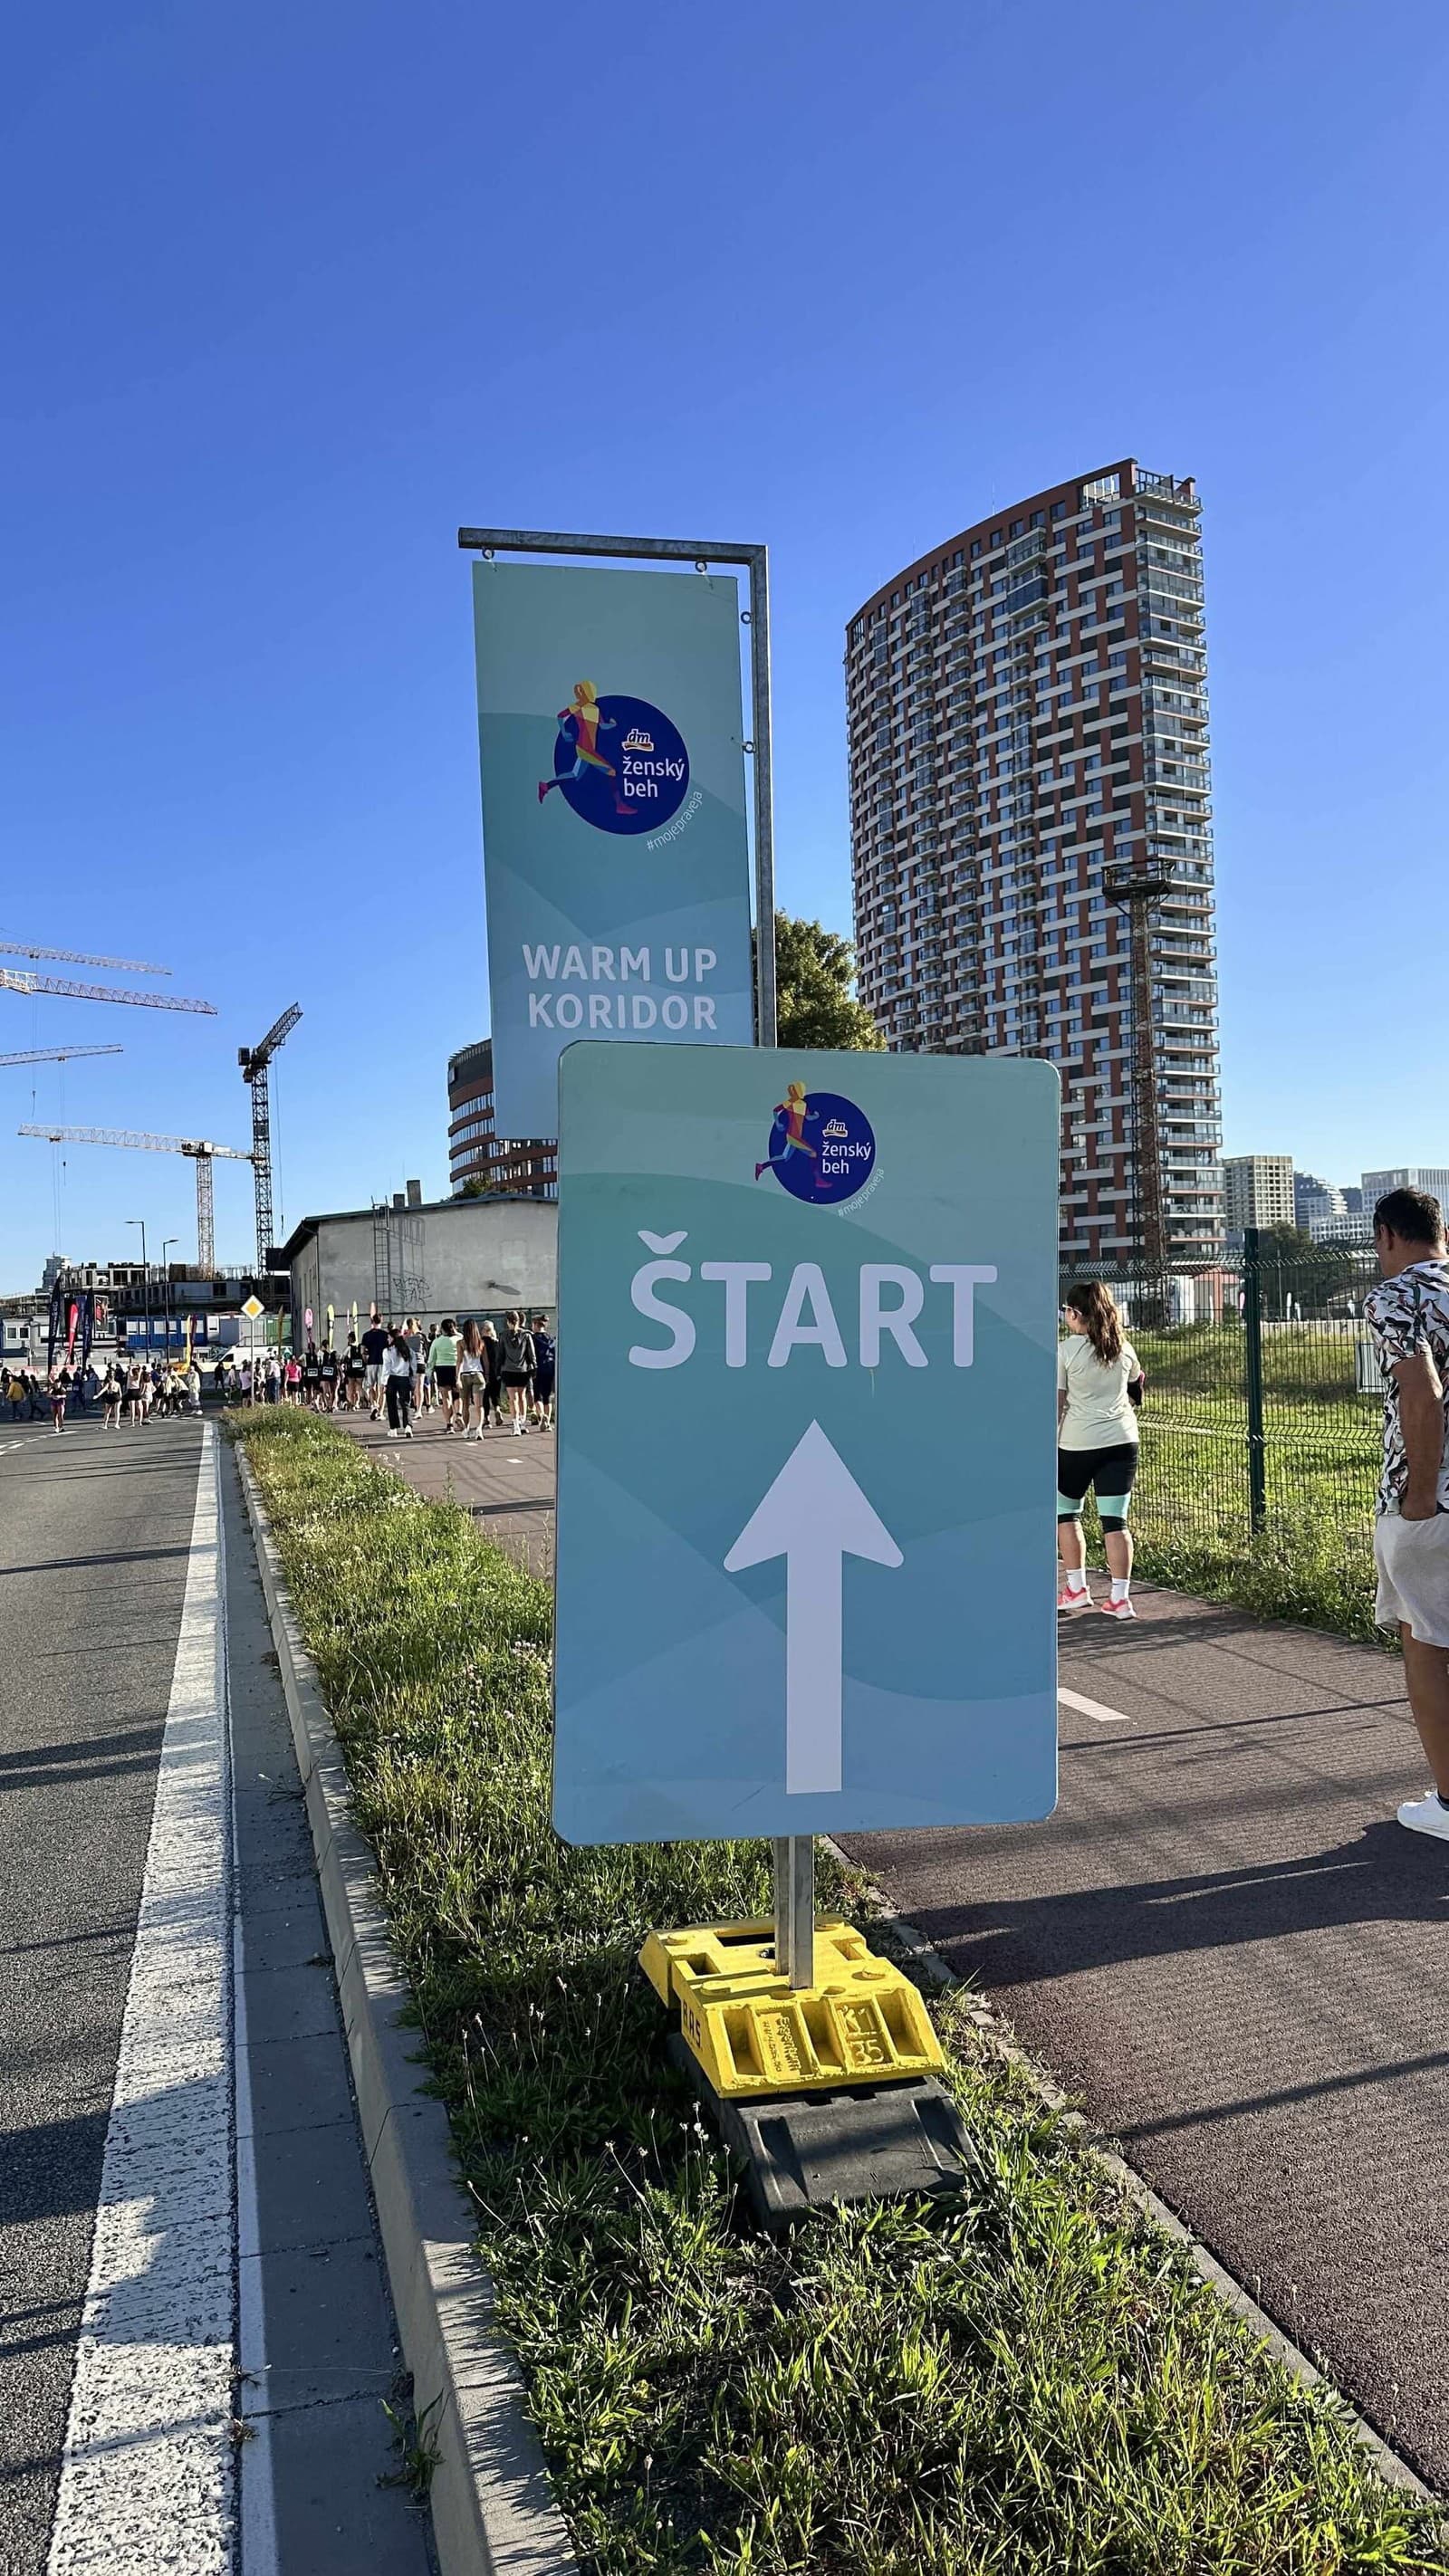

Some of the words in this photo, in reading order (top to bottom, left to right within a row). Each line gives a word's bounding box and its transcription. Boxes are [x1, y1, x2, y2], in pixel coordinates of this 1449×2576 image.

[626, 728, 651, 745] dm
[622, 755, 685, 781] ženský
[623, 778, 658, 798] beh
[646, 790, 703, 851] #mojepraveja
[522, 944, 650, 982] WARM
[665, 947, 717, 982] UP
[528, 992, 717, 1029] KORIDOR
[825, 1118, 847, 1133] dm
[821, 1141, 871, 1161] ženský
[822, 1158, 849, 1174] beh
[837, 1167, 885, 1218] #mojepraveja
[629, 1230, 998, 1369] ŠTART
[850, 2038, 885, 2066] 35
